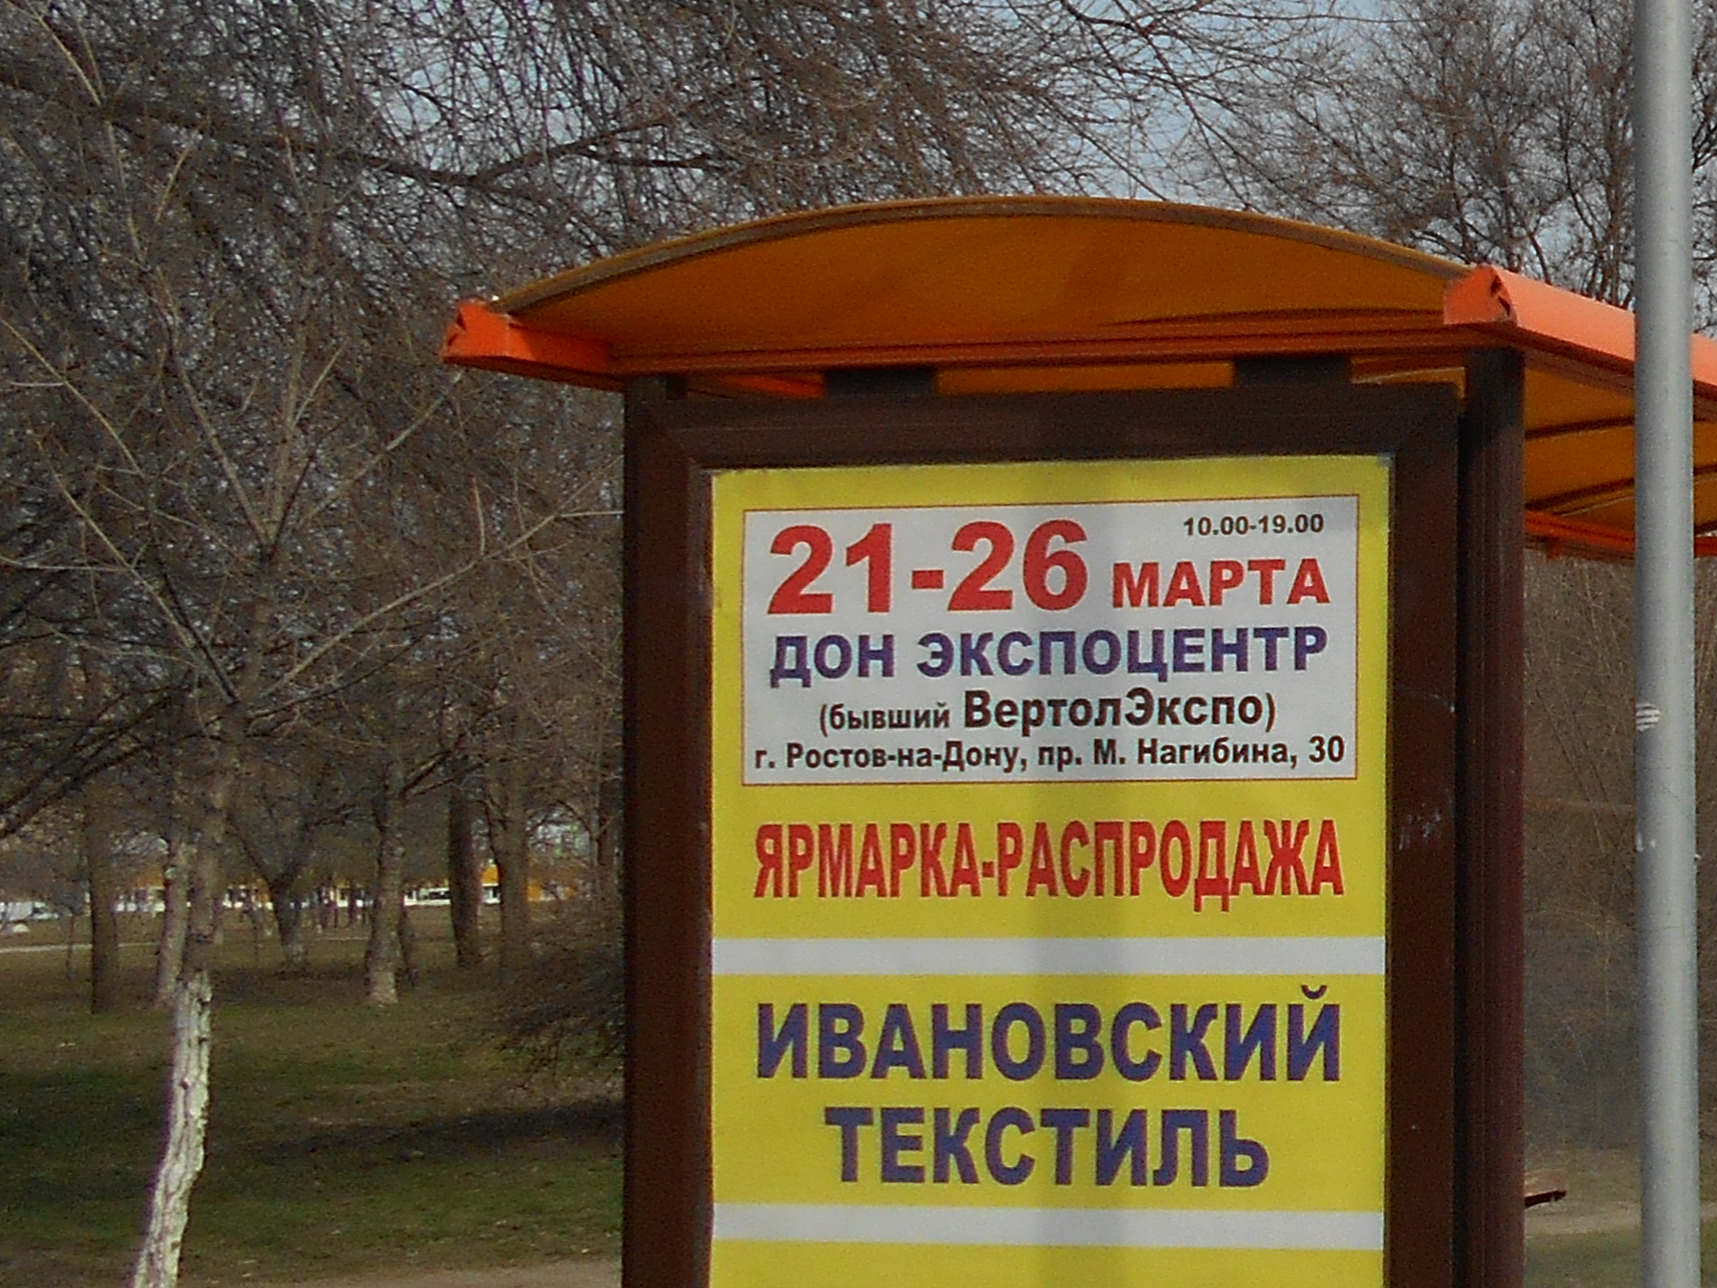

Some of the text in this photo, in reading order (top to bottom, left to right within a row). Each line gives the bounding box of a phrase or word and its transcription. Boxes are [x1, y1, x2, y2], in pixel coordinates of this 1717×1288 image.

[1184, 513, 1325, 536] 10.00-19.00
[767, 518, 1331, 615] 21-26 МАРТА
[769, 626, 1328, 689] ДОН ЭКСПОЦЕНТР
[819, 686, 1277, 738] (бывший ВертолЭкспо)
[754, 735, 1346, 774] г. Ростов-на-Дону, пр. М. Нагибина, 30
[754, 819, 1345, 912] ЯРМАРКА-РАСПРОДАЖА
[756, 984, 1342, 1083] ИВАНОВСКИЙ
[823, 1106, 1270, 1188] ТЕКСТИЛЬ
